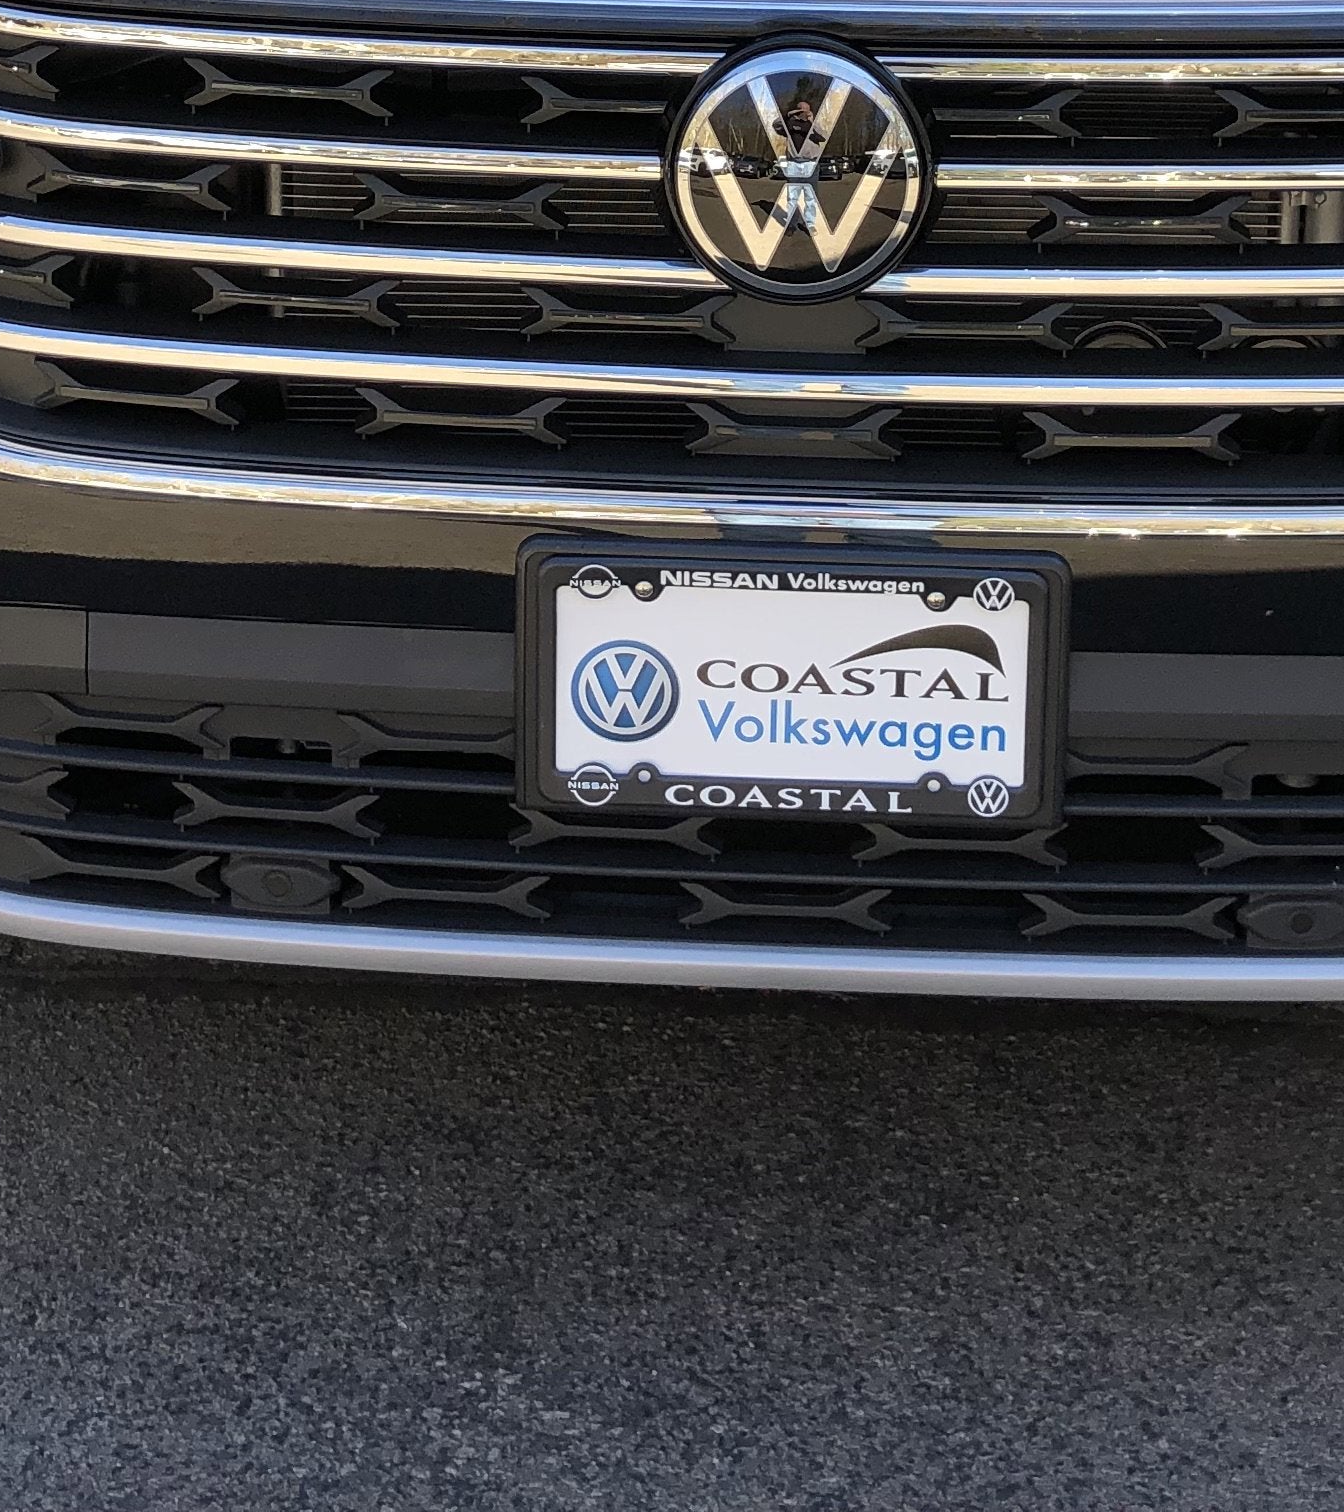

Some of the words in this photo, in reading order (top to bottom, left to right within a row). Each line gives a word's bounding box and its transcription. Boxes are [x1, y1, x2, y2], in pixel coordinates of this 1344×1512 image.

[569, 579, 622, 588] NISSAN
[660, 570, 779, 590] NISSAN
[787, 572, 925, 594] Volkswagen
[696, 659, 1010, 702] COASTAL
[697, 699, 1006, 761] Volkswagen
[567, 780, 619, 792] NISSAN
[664, 784, 913, 814] COASTAL
